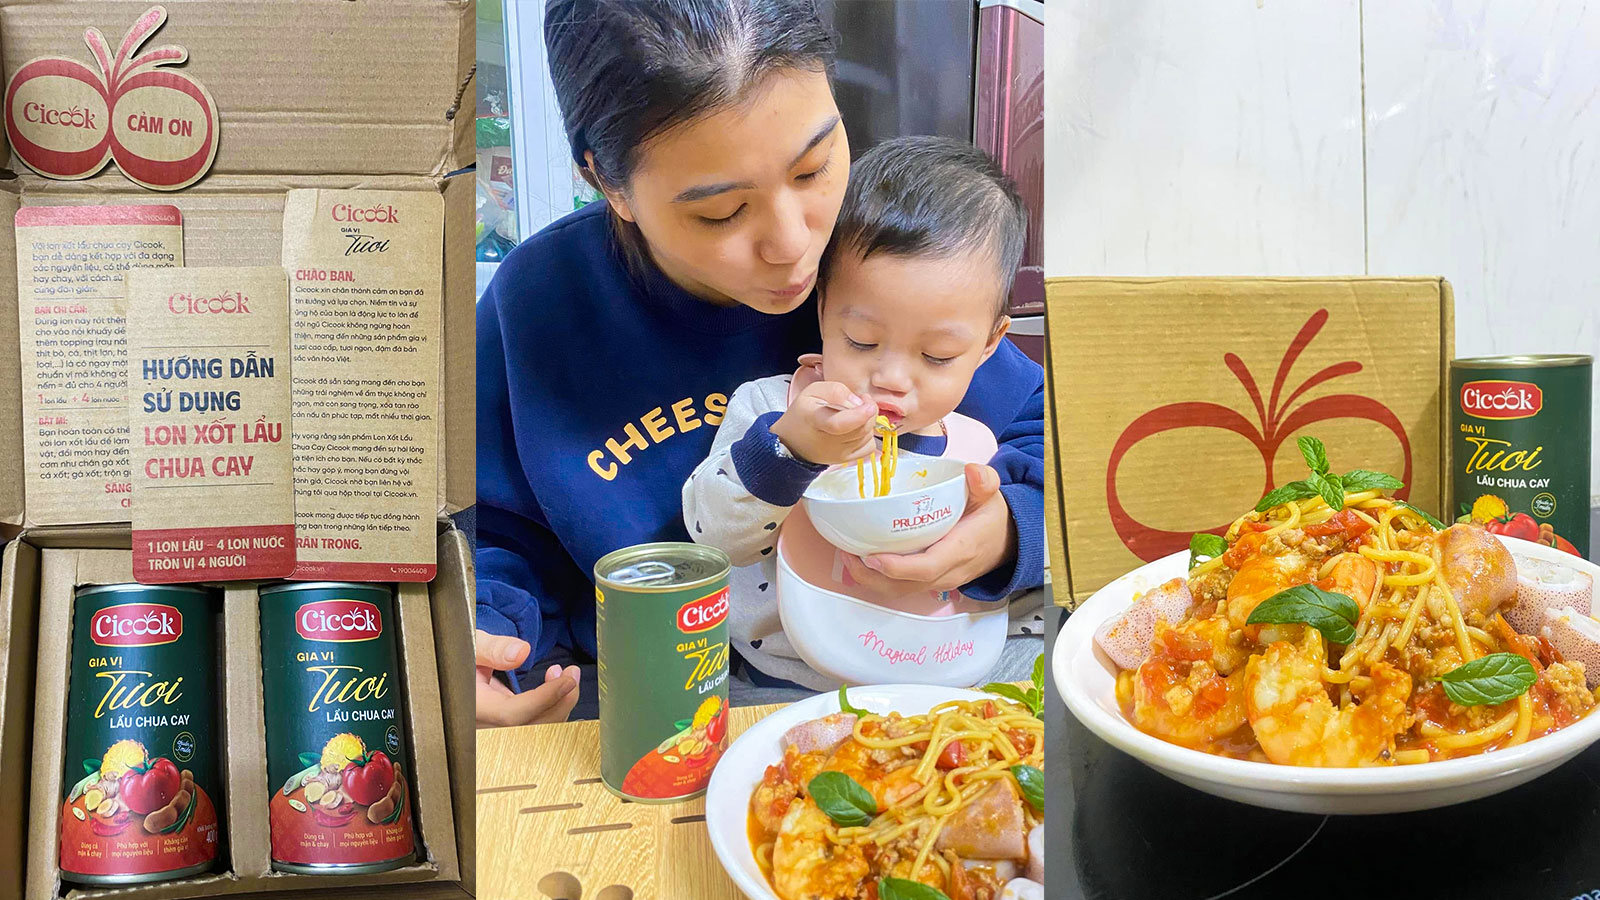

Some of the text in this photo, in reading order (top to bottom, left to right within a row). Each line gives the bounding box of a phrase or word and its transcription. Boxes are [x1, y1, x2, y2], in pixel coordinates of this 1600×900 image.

[24, 102, 97, 130] Cicook
[127, 111, 193, 137] CẢM ƠN
[331, 203, 400, 224] Cicook
[345, 234, 390, 256] Tươi
[295, 268, 356, 283] CHÀO BẠN,
[168, 290, 252, 315] Cicook
[143, 350, 274, 380] HƯỚNG DẪN
[143, 387, 241, 415] SỬ DỤNG
[1463, 387, 1535, 410] Cicook
[144, 415, 282, 446] LON XỐT LẨU
[587, 392, 728, 481] CHEES
[1460, 423, 1486, 437] GIA VỊ
[144, 455, 254, 479] CHUA CAY
[1465, 436, 1543, 474] Tươi
[1476, 473, 1550, 488] LẨU CHUA CAY
[892, 505, 952, 529] PRUDENTIAL
[148, 542, 153, 553] 1
[156, 540, 179, 553] LON
[182, 536, 204, 552] LẨU
[216, 539, 224, 550] 4
[227, 538, 249, 550] LON
[253, 535, 285, 549] NƯỚC
[296, 535, 318, 549] RÂN
[148, 554, 246, 570] TRÒN VỊ 4 NGƯỜI
[95, 610, 176, 638] Cicook
[302, 607, 378, 632] Cicook
[296, 651, 335, 663] GIA VỊ
[676, 637, 708, 653] GIA VỊ
[858, 630, 975, 665] Magical Holiday
[88, 656, 123, 668] GIA VỊ
[94, 670, 183, 719] Tươi
[306, 665, 388, 713] Tươi
[110, 714, 190, 729] LẨU CHUA CAY
[326, 708, 395, 722] LẨU CHUA CAY
